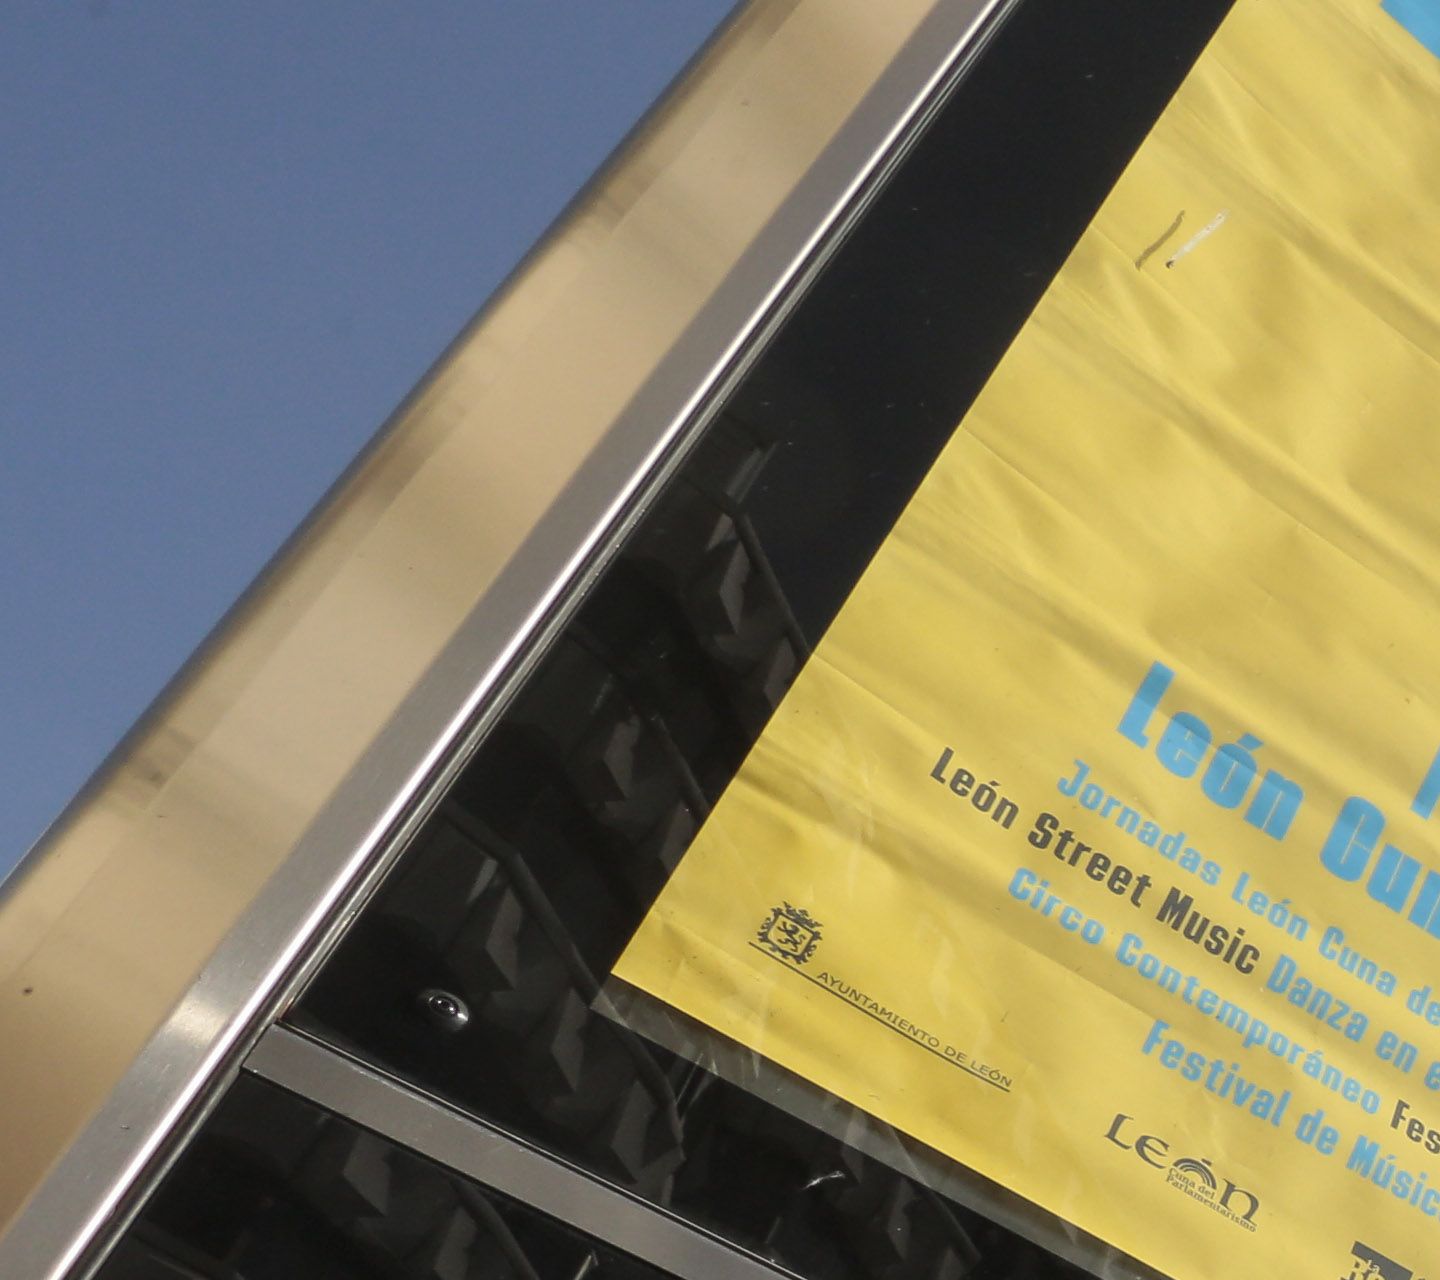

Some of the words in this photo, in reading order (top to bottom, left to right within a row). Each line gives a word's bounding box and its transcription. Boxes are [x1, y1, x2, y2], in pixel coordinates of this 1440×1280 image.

[1117, 661, 1305, 841] León
[929, 746, 1019, 830] León
[1027, 812, 1152, 908] Street
[1155, 886, 1260, 975] Music
[1266, 954, 1370, 1042] Danza
[1375, 1030, 1419, 1073] en
[1057, 759, 1223, 886] Jornadas
[1231, 872, 1311, 941] León
[1318, 926, 1398, 996] Cuna
[816, 971, 941, 1049] AYUNTAMIENTO
[943, 1044, 969, 1064] DE
[969, 1059, 1014, 1088] LEÓN
[1007, 867, 1106, 945] Circo
[1115, 932, 1382, 1115] Contemporáneo
[1142, 1019, 1293, 1126] Festival
[1295, 1109, 1341, 1156] de
[1165, 1174, 1257, 1233] Parlamentarismo
[1168, 1167, 1197, 1190] Cuna
[1198, 1184, 1216, 1201] del
